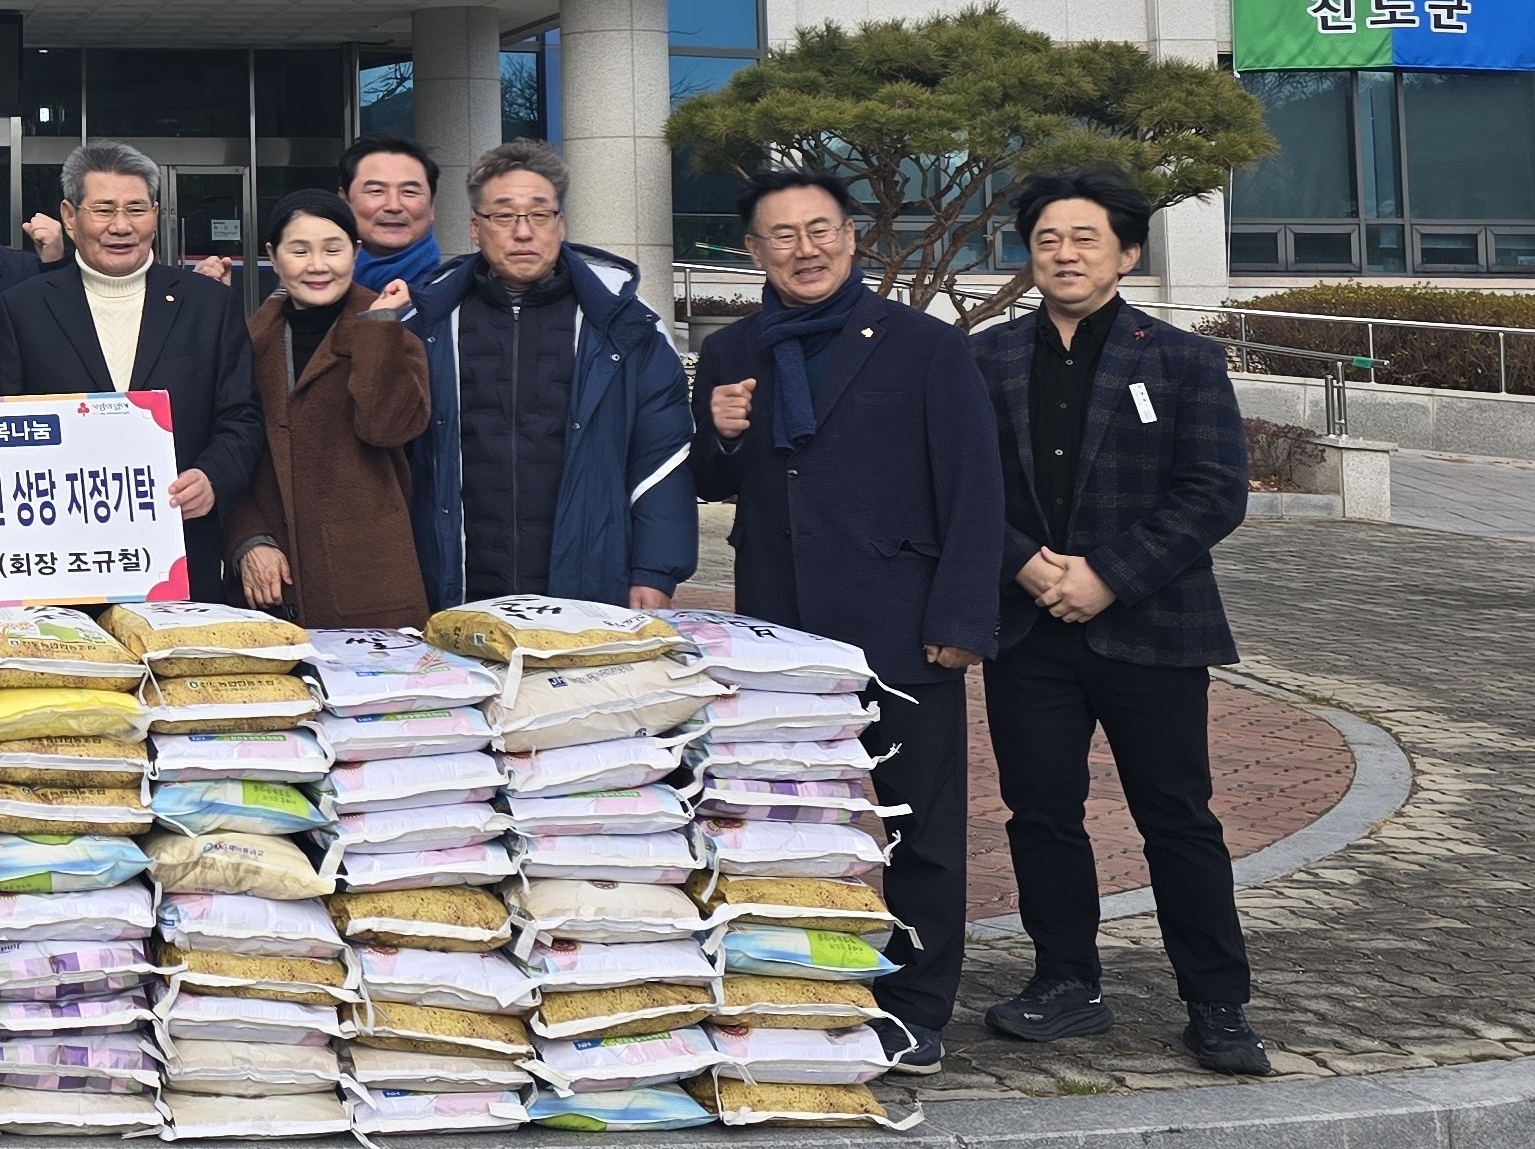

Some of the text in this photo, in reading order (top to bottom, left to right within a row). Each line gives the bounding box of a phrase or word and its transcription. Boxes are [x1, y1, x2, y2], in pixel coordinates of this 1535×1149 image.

[13, 468, 57, 528] 상당
[65, 465, 157, 524] 지정기탁
[67, 547, 152, 577] 조규철)
